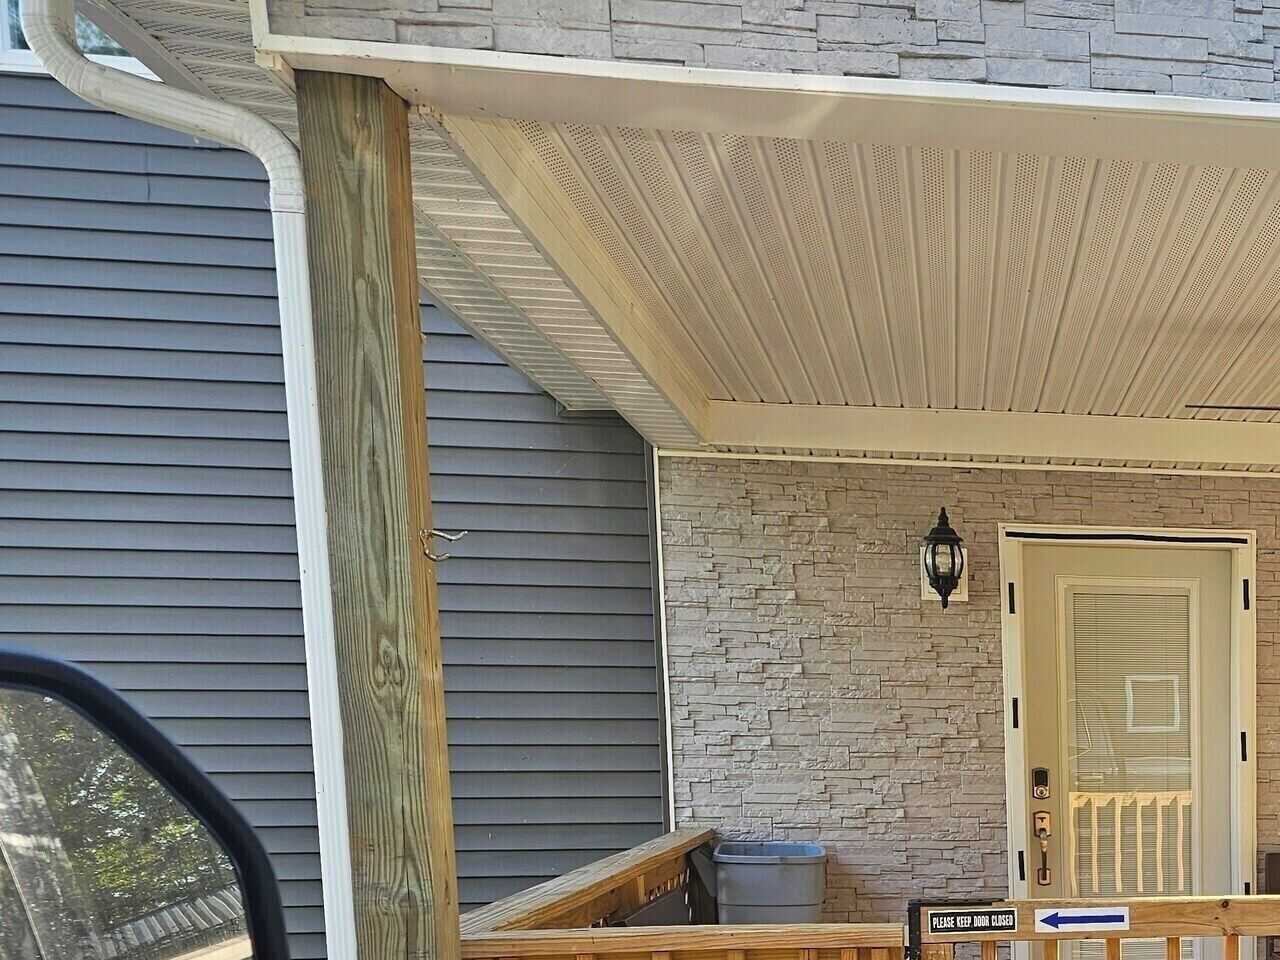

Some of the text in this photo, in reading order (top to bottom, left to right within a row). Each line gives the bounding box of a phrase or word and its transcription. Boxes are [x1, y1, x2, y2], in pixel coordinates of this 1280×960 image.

[932, 914, 1014, 929] PLEASE KEEP DOOR CLOSED
